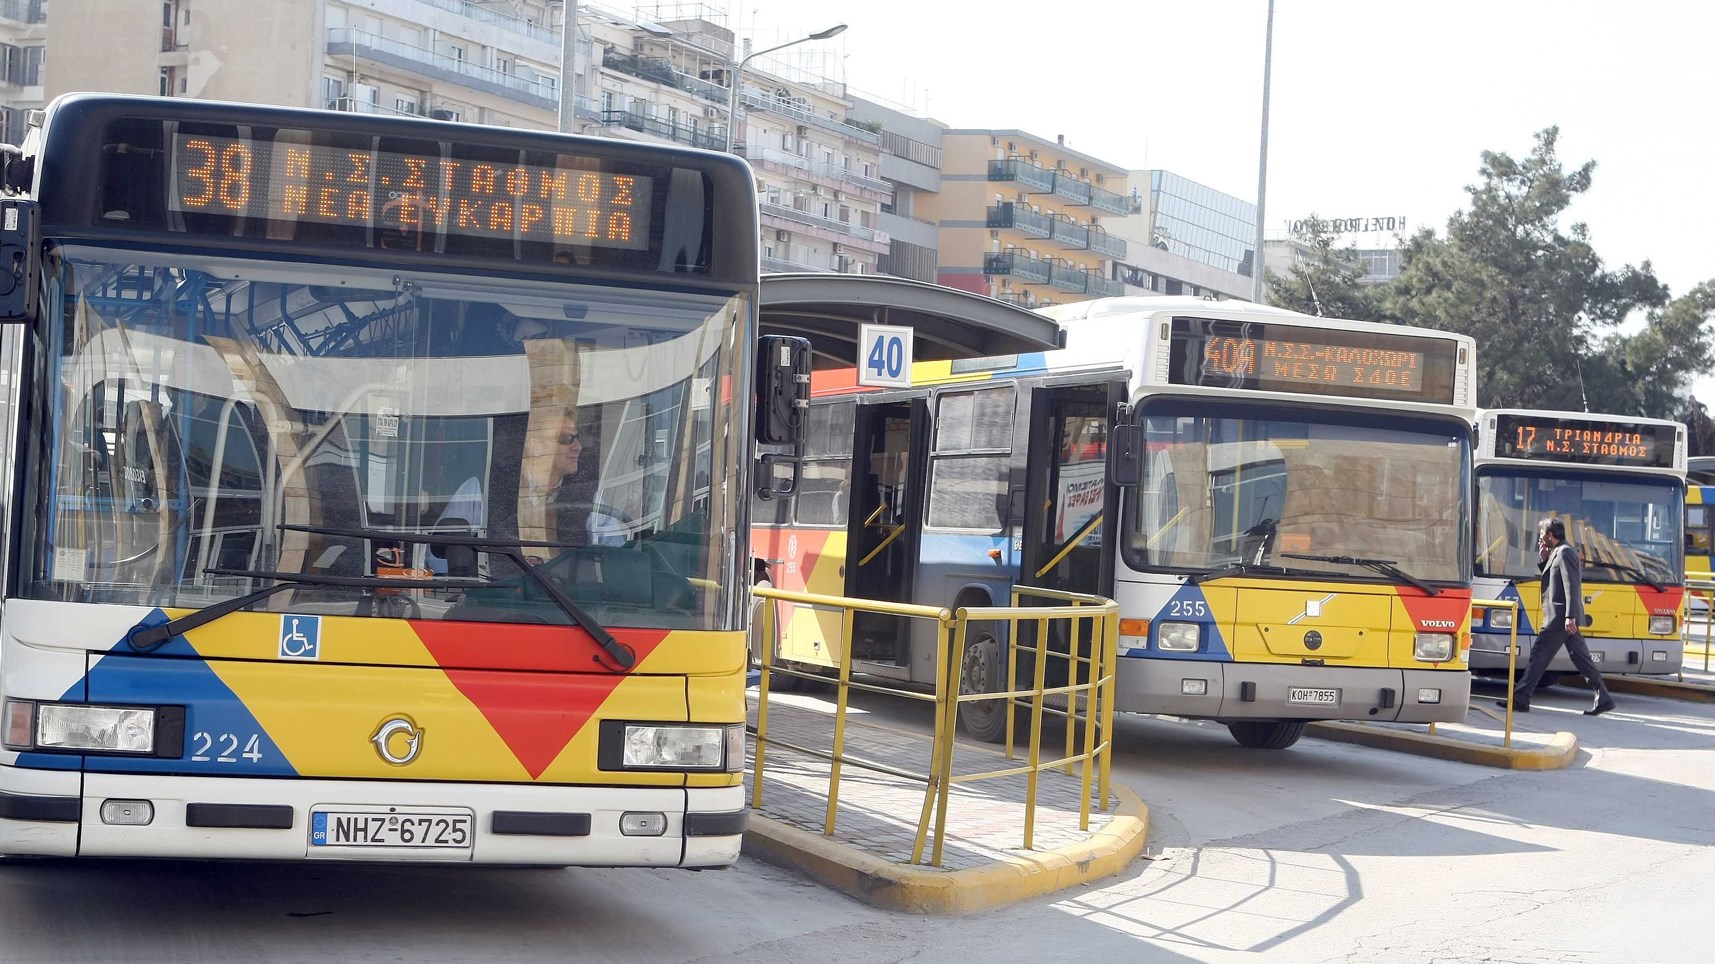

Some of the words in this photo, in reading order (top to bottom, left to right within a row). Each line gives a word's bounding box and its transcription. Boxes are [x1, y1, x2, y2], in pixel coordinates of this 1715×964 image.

[184, 140, 252, 209] 38
[284, 185, 371, 219] ΝΕΑ
[400, 194, 631, 240] ΕΥΚΑΡΠΙΑ
[868, 335, 903, 378] 40
[1275, 361, 1337, 381] ΜΕΣΩ
[1353, 367, 1411, 387] ΣΔΟΕ
[1516, 426, 1536, 450] 17
[1546, 440, 1576, 453] Ν.Σ.
[1582, 443, 1647, 458] ΣΤΑΘΜΟΣ
[1554, 428, 1641, 445] ΤΡΙΑΝΔΡΙΑ
[1170, 600, 1205, 616] 255
[1421, 619, 1456, 628] VOLVO
[191, 731, 263, 763] 224
[313, 831, 326, 839] GR
[335, 816, 468, 845] NHZ-6725
